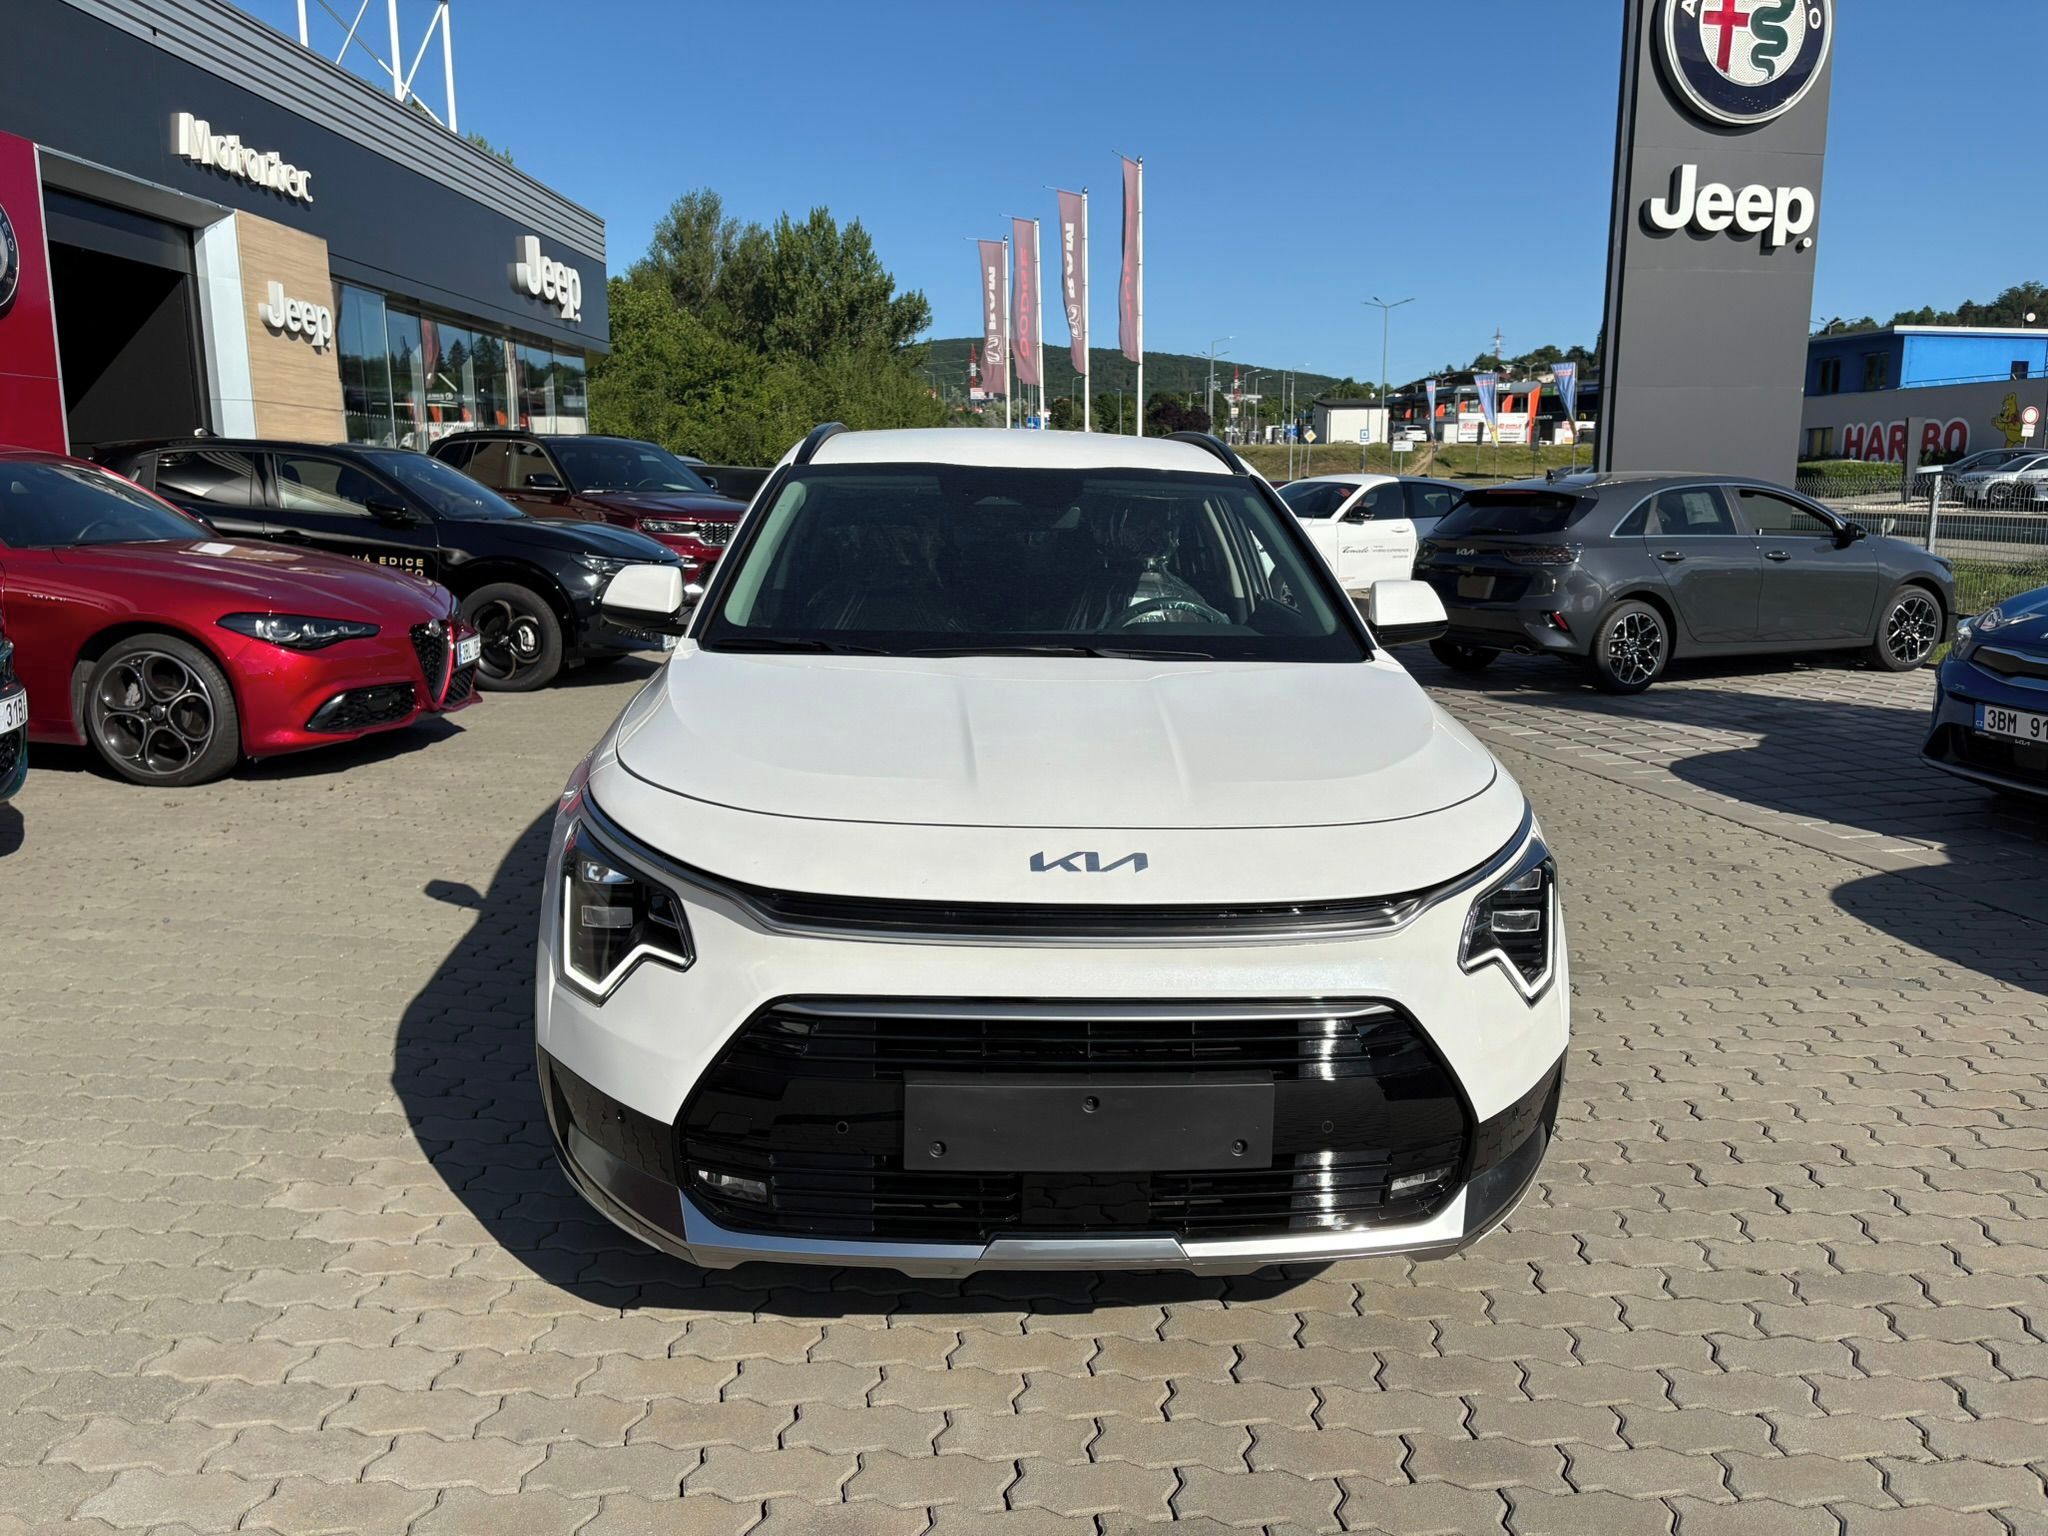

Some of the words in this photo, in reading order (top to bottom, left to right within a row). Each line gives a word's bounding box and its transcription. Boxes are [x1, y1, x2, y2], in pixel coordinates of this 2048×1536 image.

[171, 112, 313, 203] Motortec
[1650, 164, 1815, 247] Jeep
[510, 235, 582, 322] Jeep
[258, 281, 332, 348] Jeep
[1841, 418, 1970, 462] HARBO
[379, 556, 424, 567] EDICE
[1455, 548, 1475, 556] KIA
[1987, 709, 2018, 734] 3BM
[1029, 850, 1149, 873] KIA
